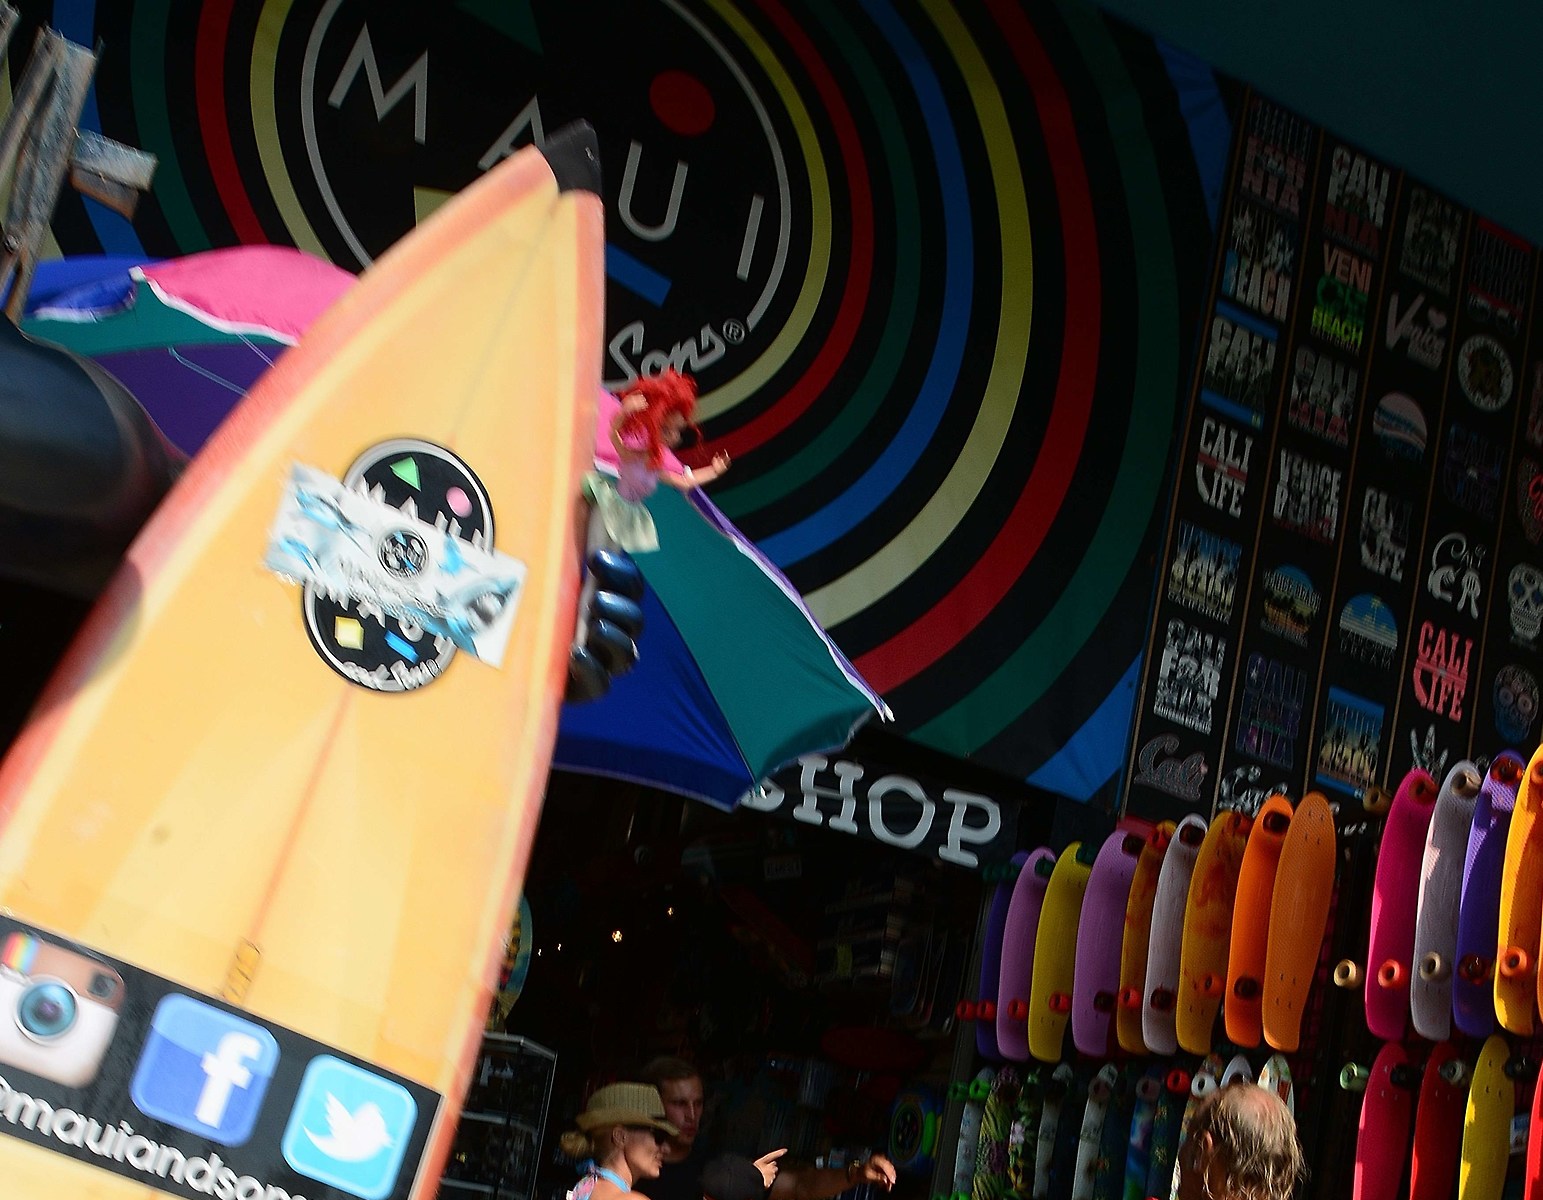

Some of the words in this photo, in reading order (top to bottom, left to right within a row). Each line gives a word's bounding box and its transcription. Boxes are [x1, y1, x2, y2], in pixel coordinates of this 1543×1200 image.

[328, 21, 764, 282] MAUI
[1323, 239, 1373, 294] VENI
[1199, 416, 1254, 476] CALI
[1281, 448, 1341, 499] VENICE
[1195, 459, 1247, 519] LIFE
[1418, 619, 1474, 680] CALI
[1413, 664, 1467, 723] LIFE
